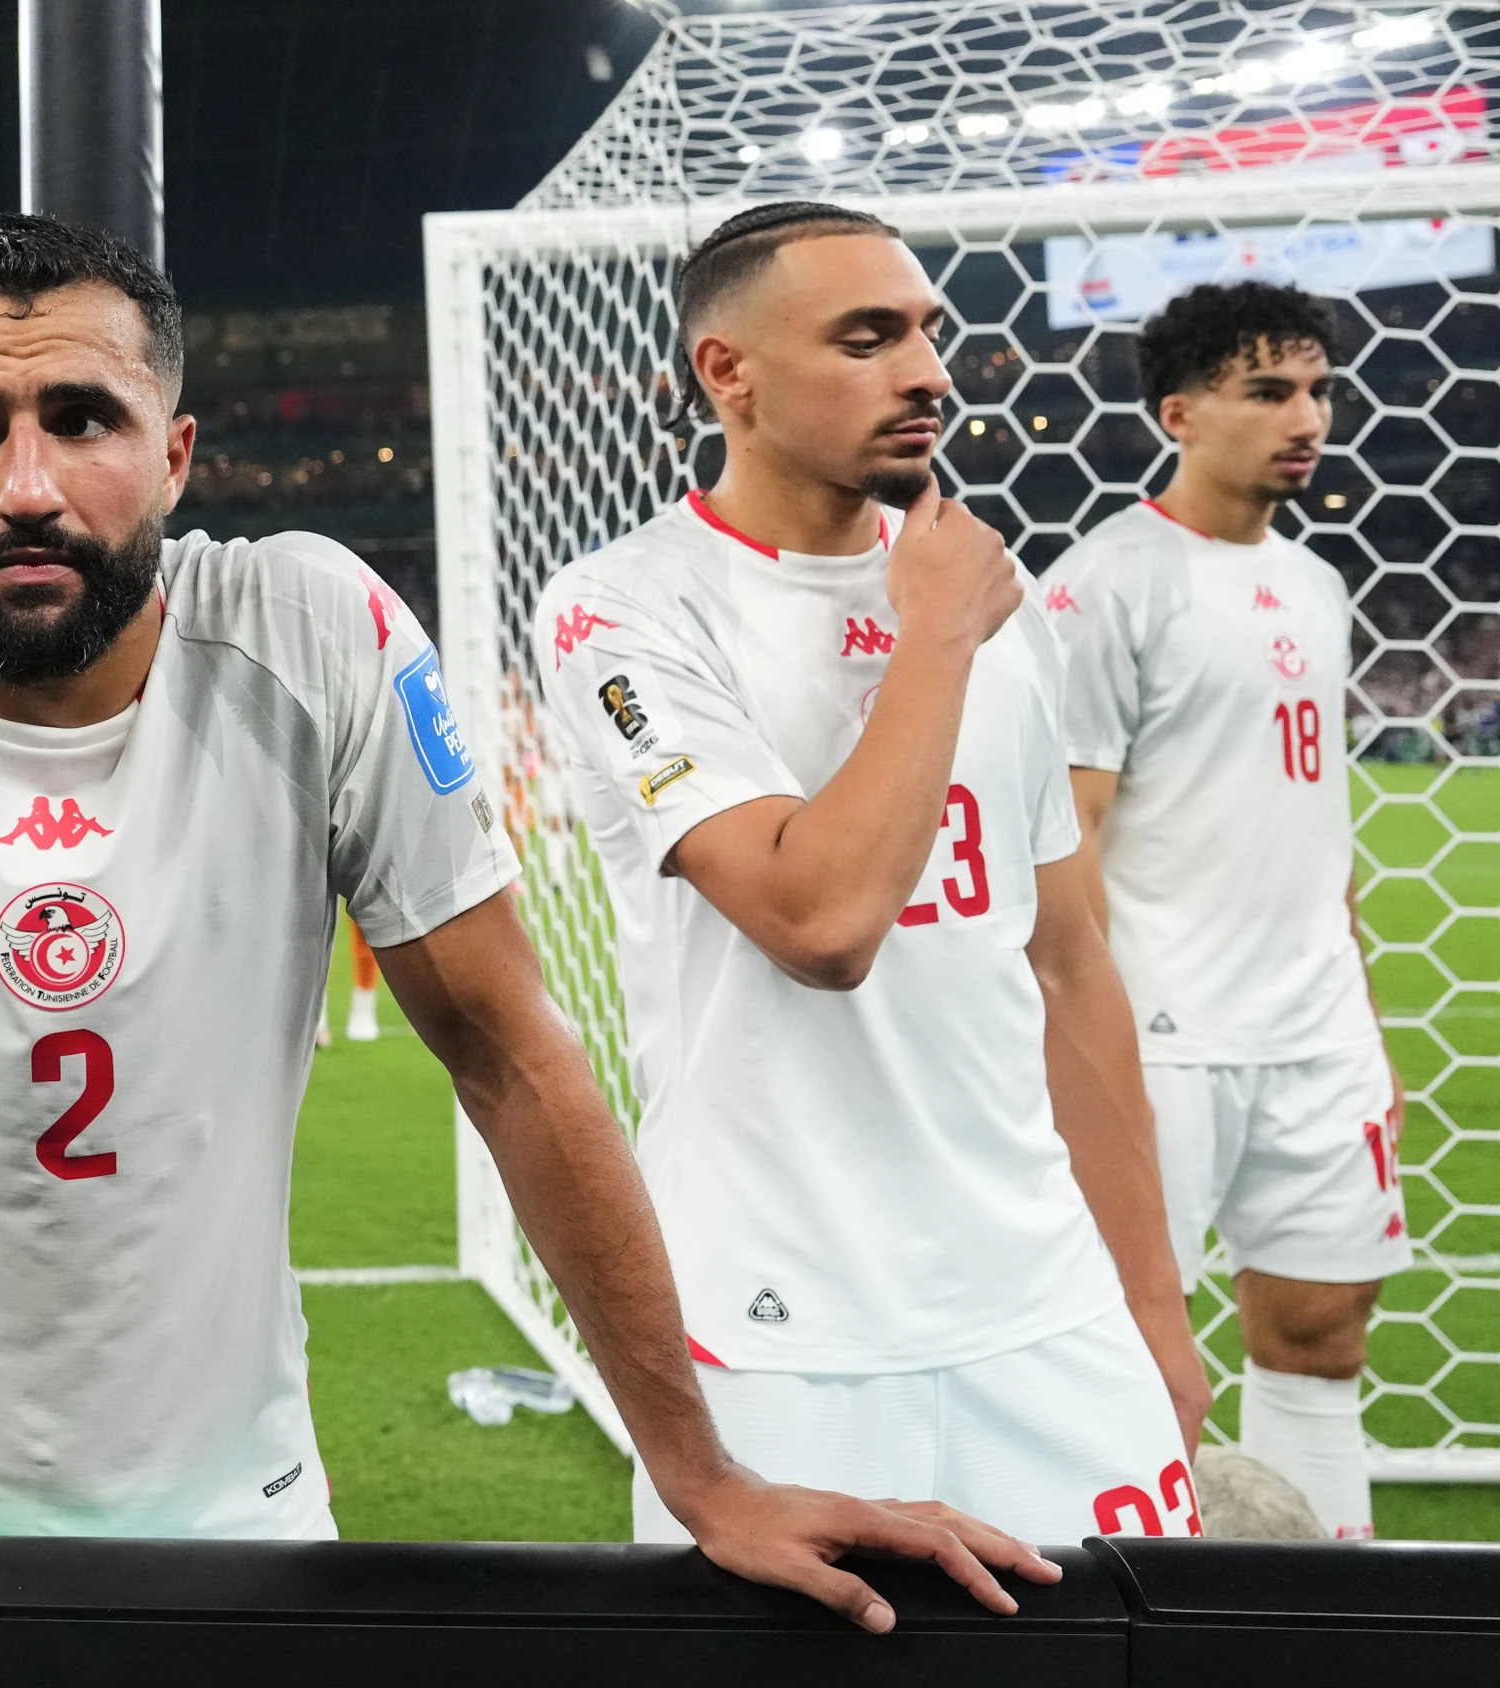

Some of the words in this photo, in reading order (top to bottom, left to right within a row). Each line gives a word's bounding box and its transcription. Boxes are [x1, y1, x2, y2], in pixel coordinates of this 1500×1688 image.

[631, 735, 659, 760] 2026
[1274, 698, 1320, 783] 18
[650, 759, 686, 788] DEBUT
[895, 783, 990, 928] 3
[25, 887, 87, 909] تونس
[0, 952, 36, 996] FEDERATION
[37, 988, 90, 1003] TUNISIENNE
[90, 979, 102, 991] DE
[98, 938, 118, 981] FOOTBALL
[31, 1029, 117, 1180] 2
[266, 1464, 301, 1495] KOMBAT
